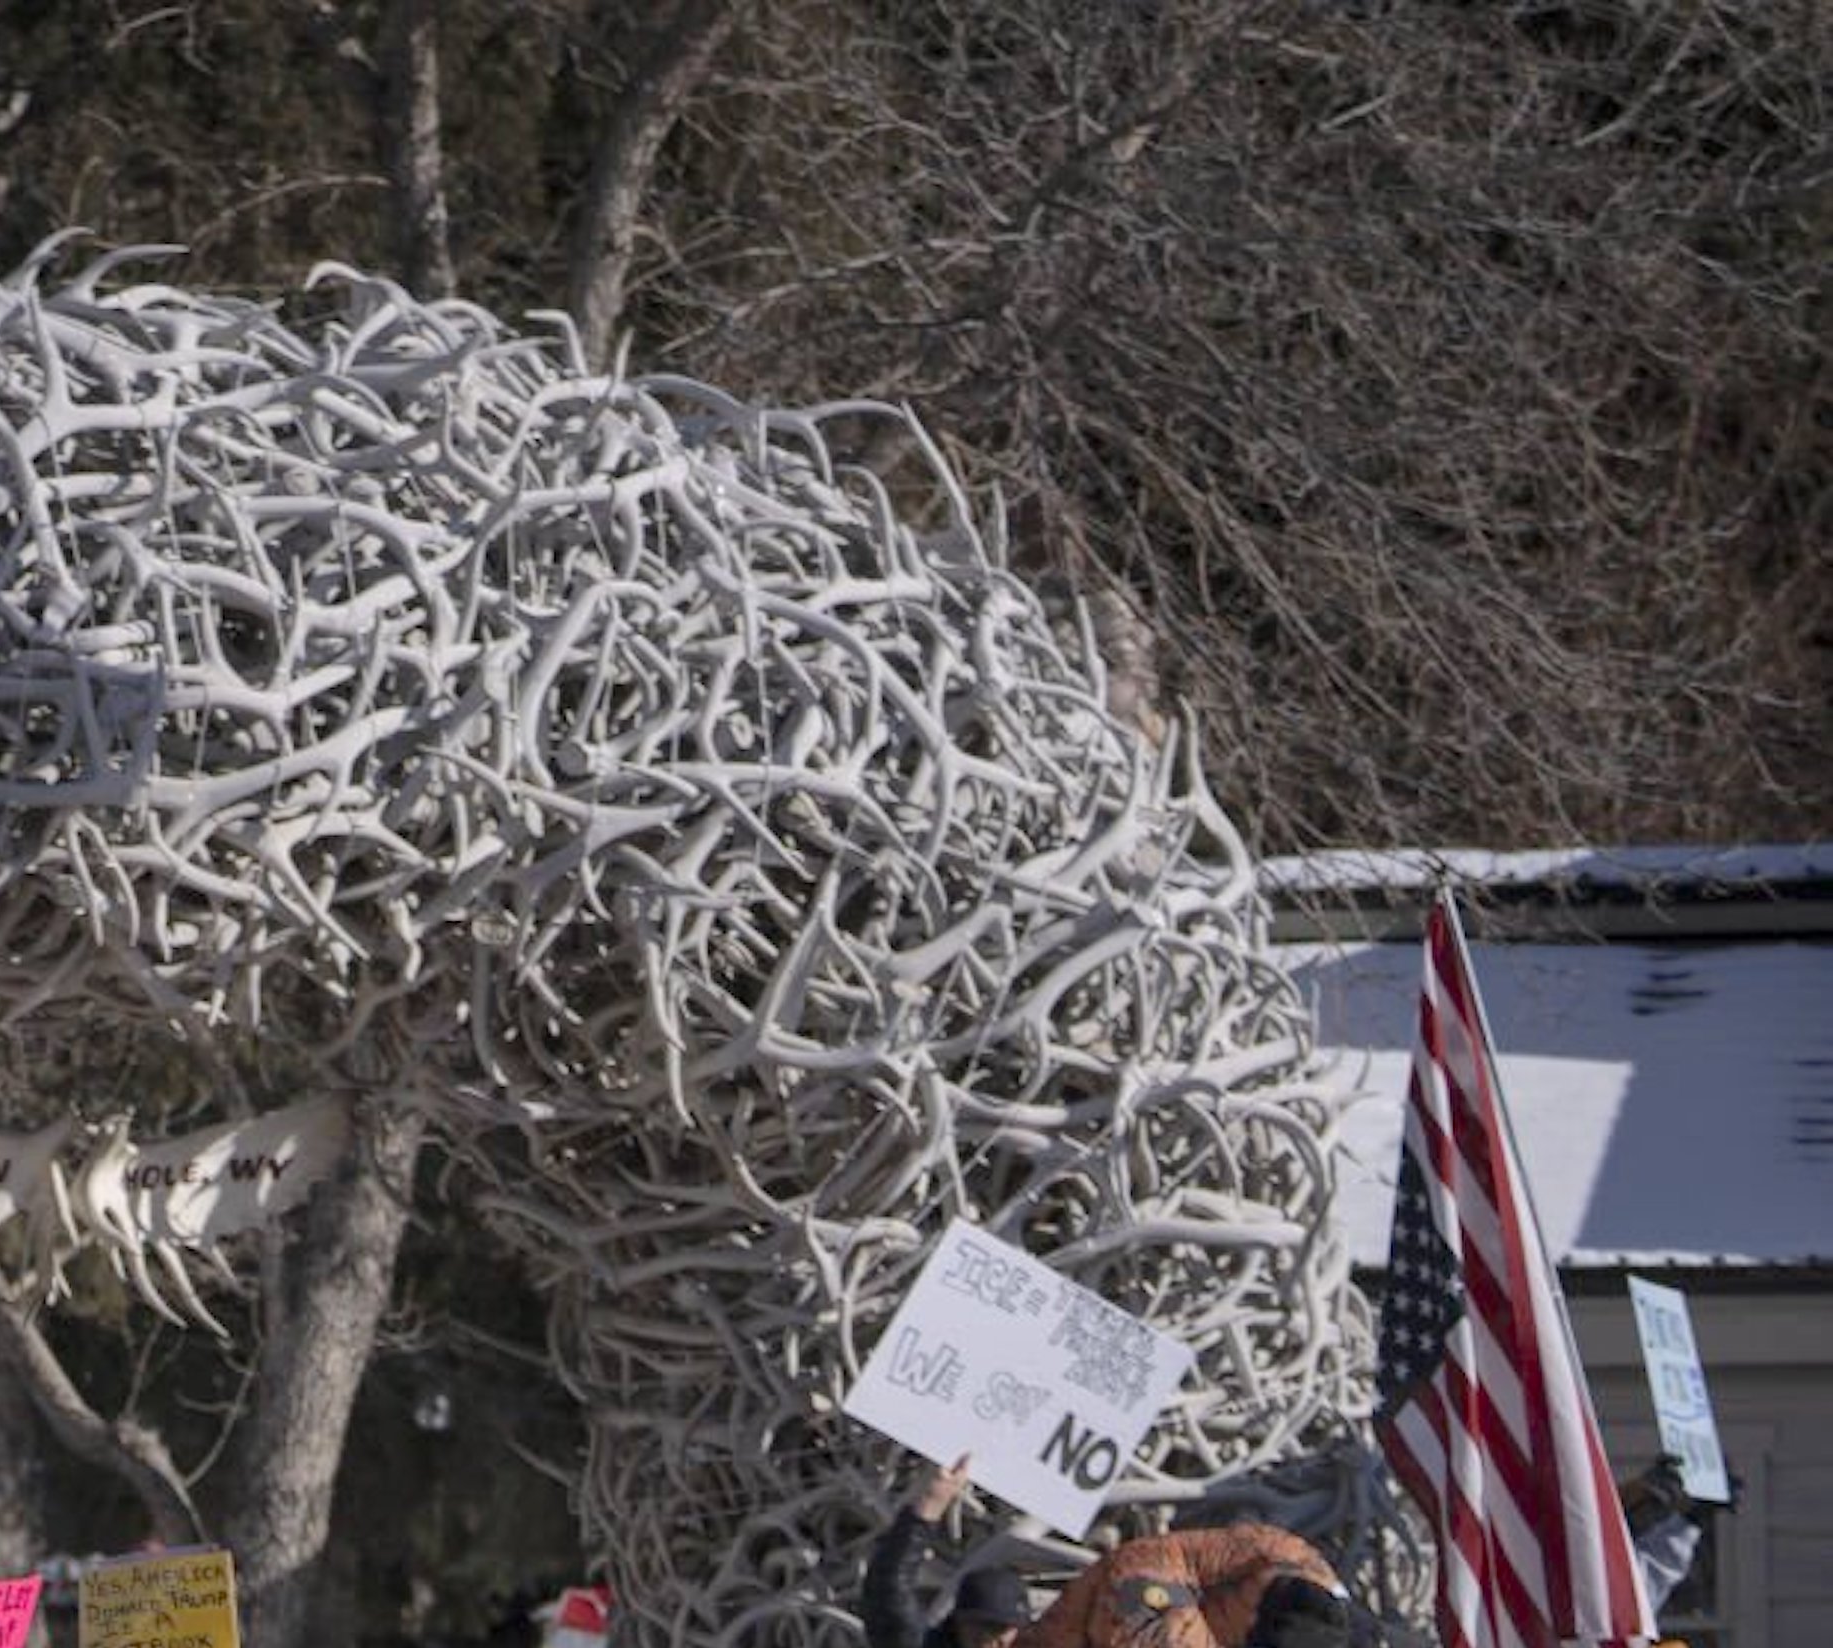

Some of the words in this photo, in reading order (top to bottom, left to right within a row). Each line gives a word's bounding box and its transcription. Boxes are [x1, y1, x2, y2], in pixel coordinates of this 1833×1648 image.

[229, 1155, 293, 1181] WY
[887, 1325, 967, 1404] WE
[1039, 1410, 1120, 1491] NO
[155, 1611, 175, 1629] A
